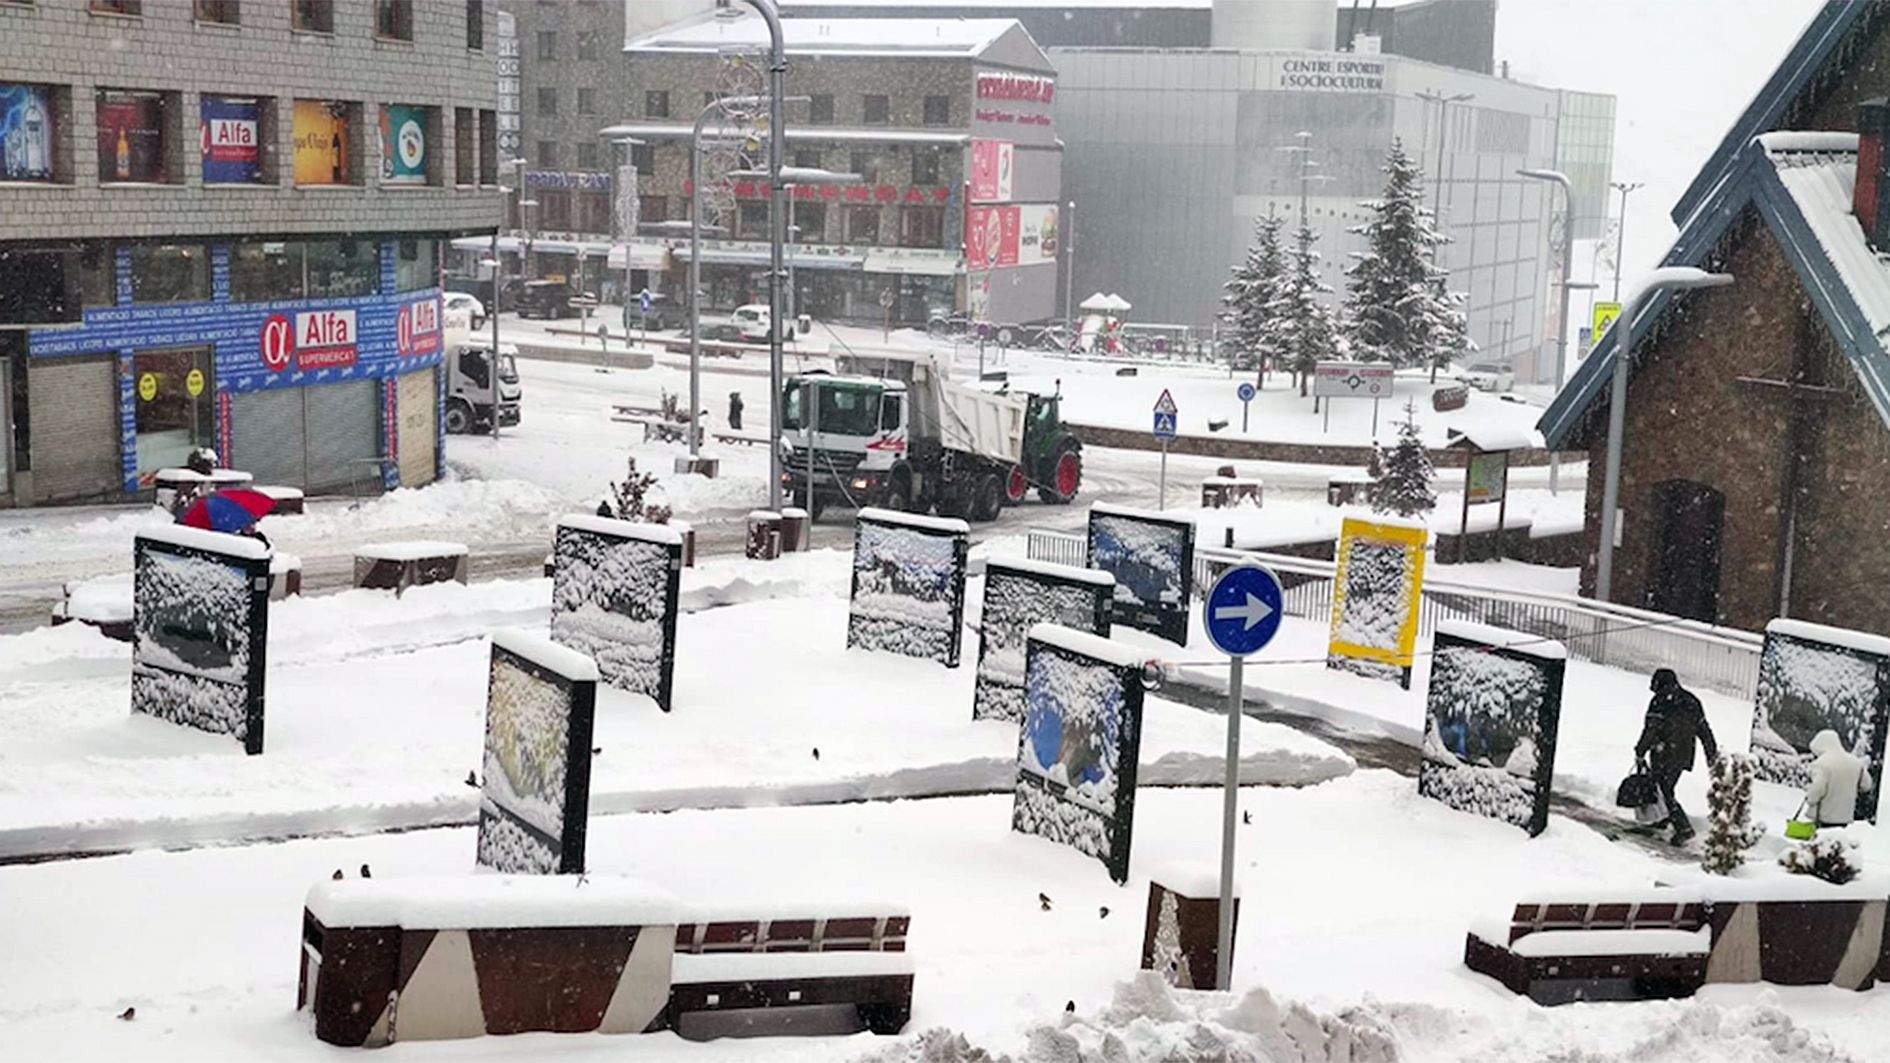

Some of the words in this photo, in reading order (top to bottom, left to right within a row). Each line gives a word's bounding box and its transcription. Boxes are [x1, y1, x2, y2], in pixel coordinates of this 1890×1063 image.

[1282, 60, 1331, 73] CENTRE
[1289, 74, 1383, 89] SOCIOCULTURAL
[218, 121, 252, 144] Alfa
[416, 302, 434, 329] Alfa
[306, 312, 347, 345] Alfa
[298, 349, 355, 366] SUPERMERCAT
